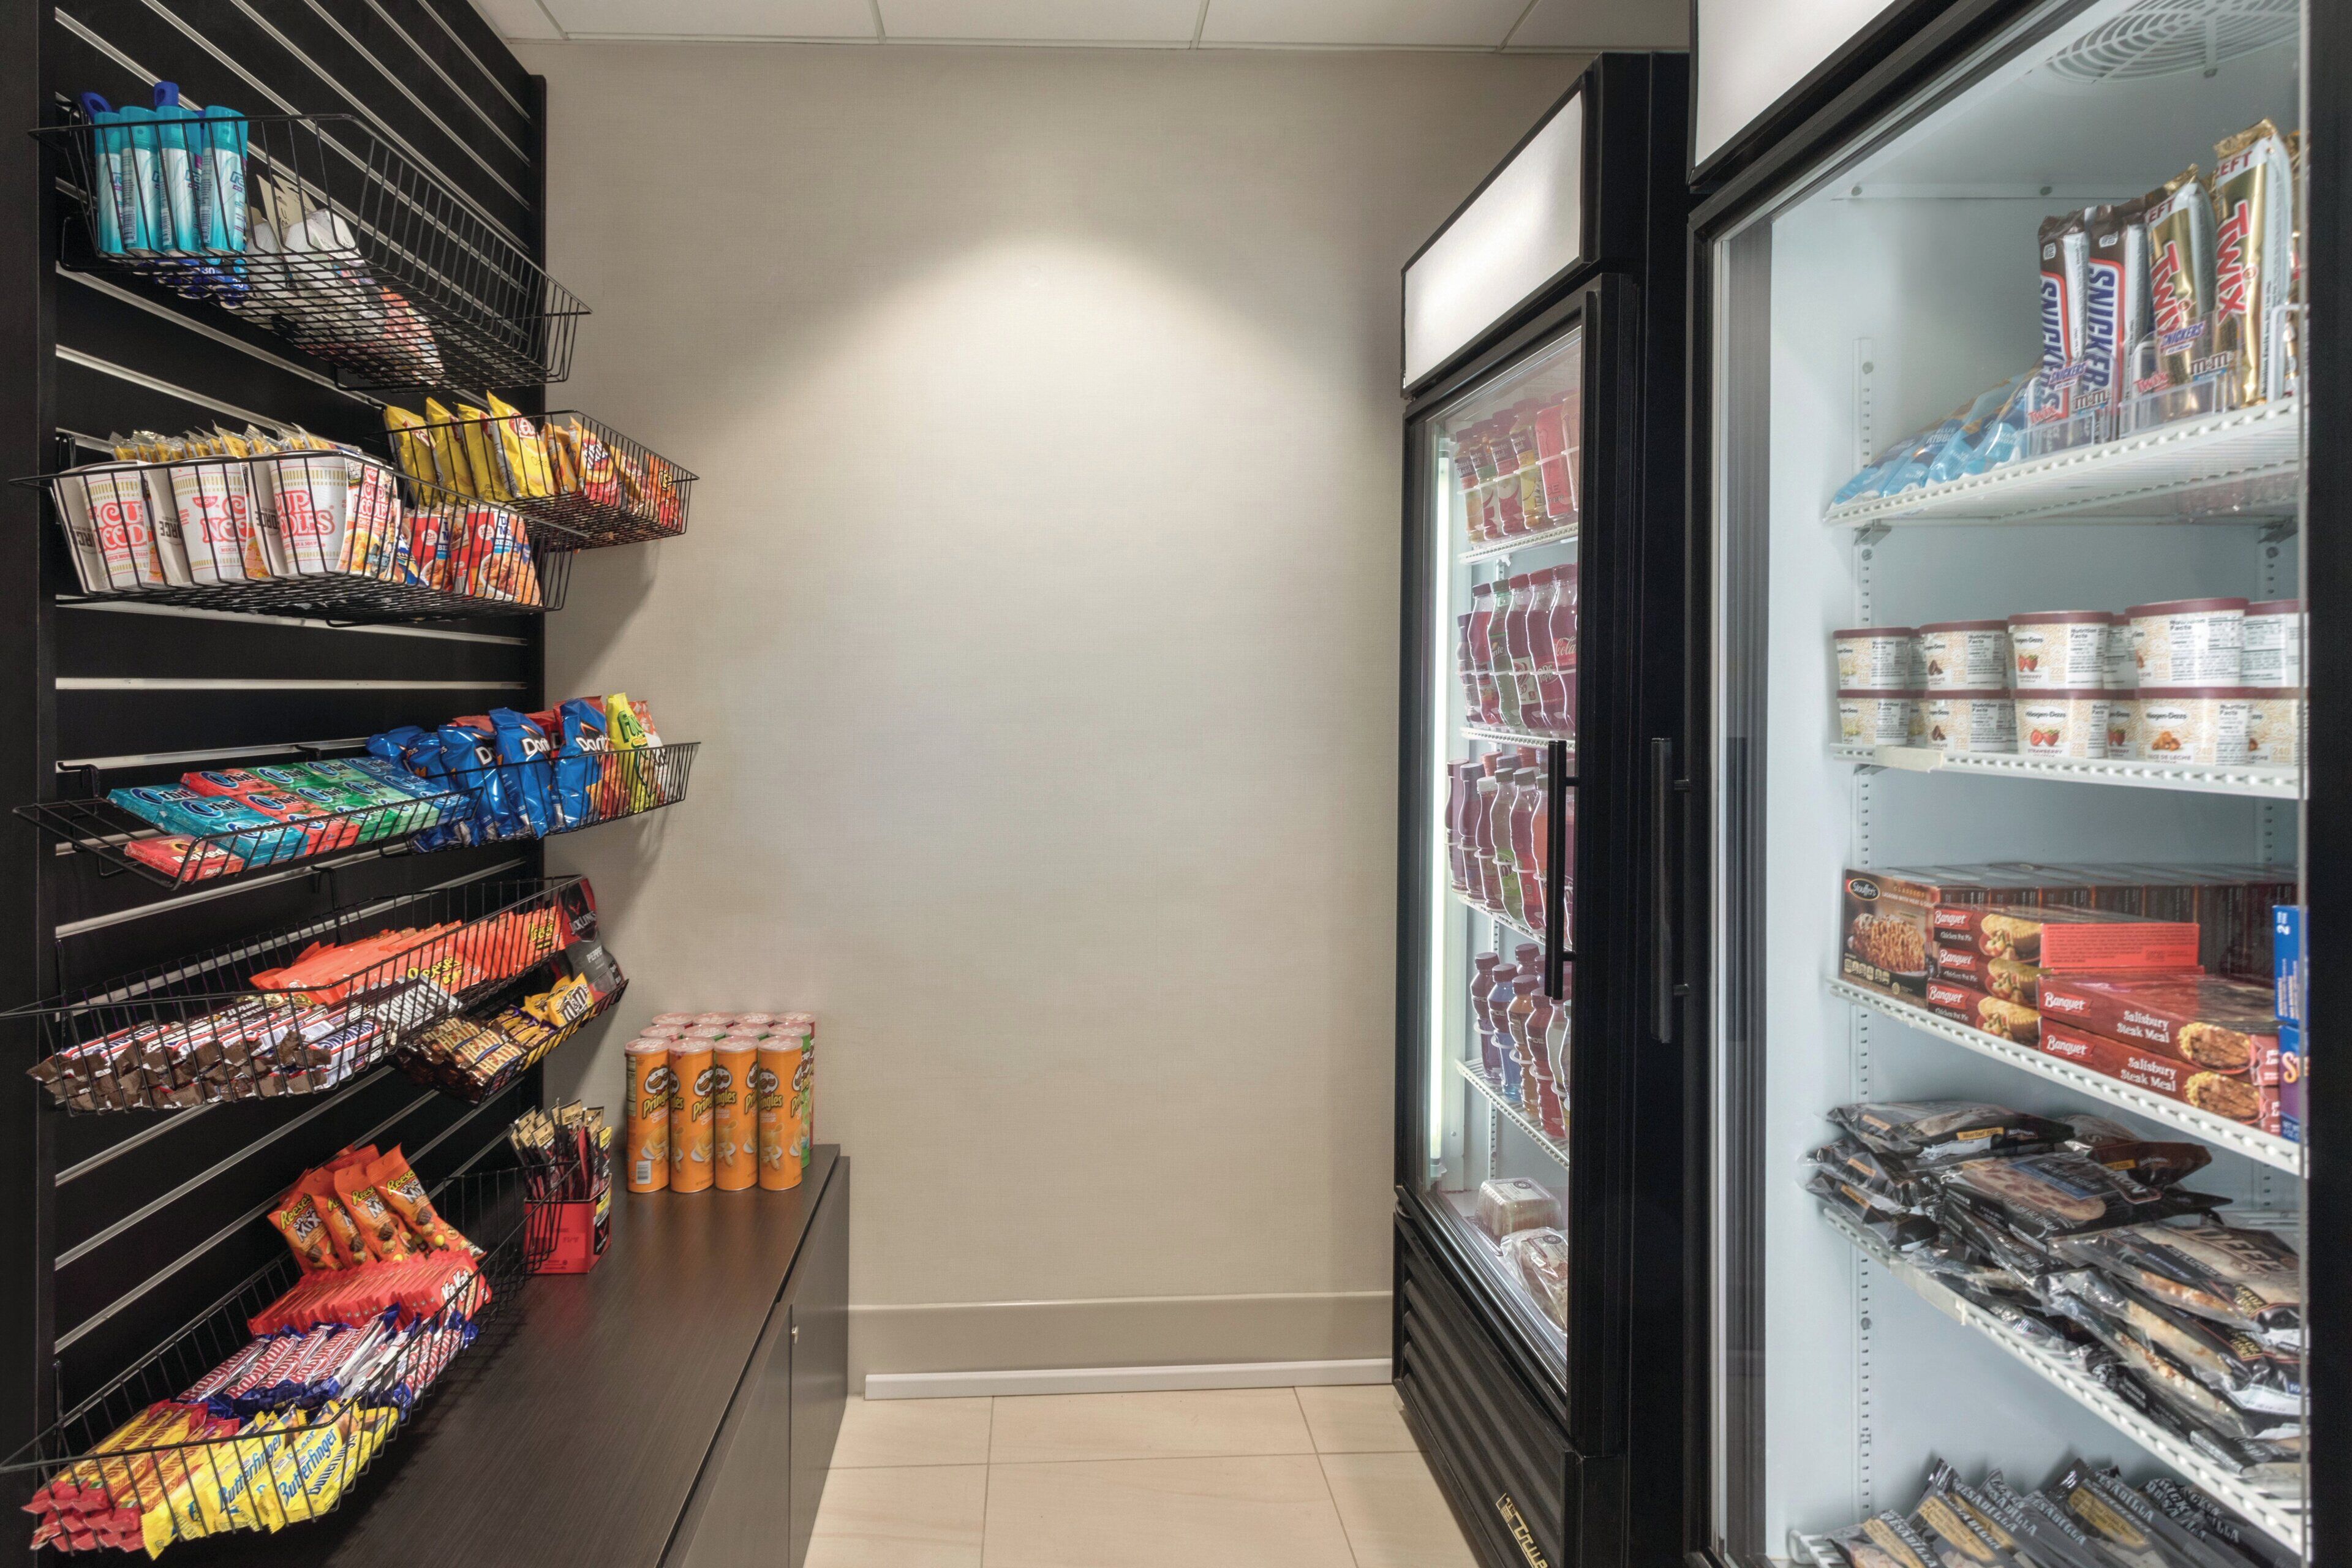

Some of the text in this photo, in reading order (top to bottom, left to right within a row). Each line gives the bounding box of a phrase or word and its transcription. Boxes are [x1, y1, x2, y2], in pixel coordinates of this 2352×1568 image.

[2160, 322, 2204, 347] SNICKERS
[2049, 360, 2089, 385] SNICKERS
[2195, 746, 2213, 756] 240
[2272, 745, 2291, 756] 240
[257, 767, 309, 784] Orbit
[306, 761, 352, 777] Orbit
[200, 771, 258, 789] Orbit
[344, 780, 387, 795] Orbit
[131, 788, 198, 805] Orbit
[247, 794, 303, 811] Orbit
[296, 786, 350, 803] Orbit
[181, 800, 246, 818] Orbit
[1934, 910, 1967, 926] Banquet
[1939, 949, 1974, 967] Banquet
[1929, 986, 1964, 1005] Banquet
[2043, 991, 2087, 1011] Banquet
[2123, 1010, 2169, 1031] Salisbury
[435, 1022, 481, 1054] HEATH
[2116, 1022, 2171, 1044] Steak Meal
[459, 1029, 504, 1066] HEATH
[2046, 1034, 2089, 1055] Banquet
[475, 1042, 522, 1076] HEATH
[2127, 1057, 2177, 1080] Salisbury
[2120, 1069, 2177, 1092] Steak Meal
[218, 1433, 282, 1514] Butterfinger
[279, 1428, 337, 1508] Butterfinger
